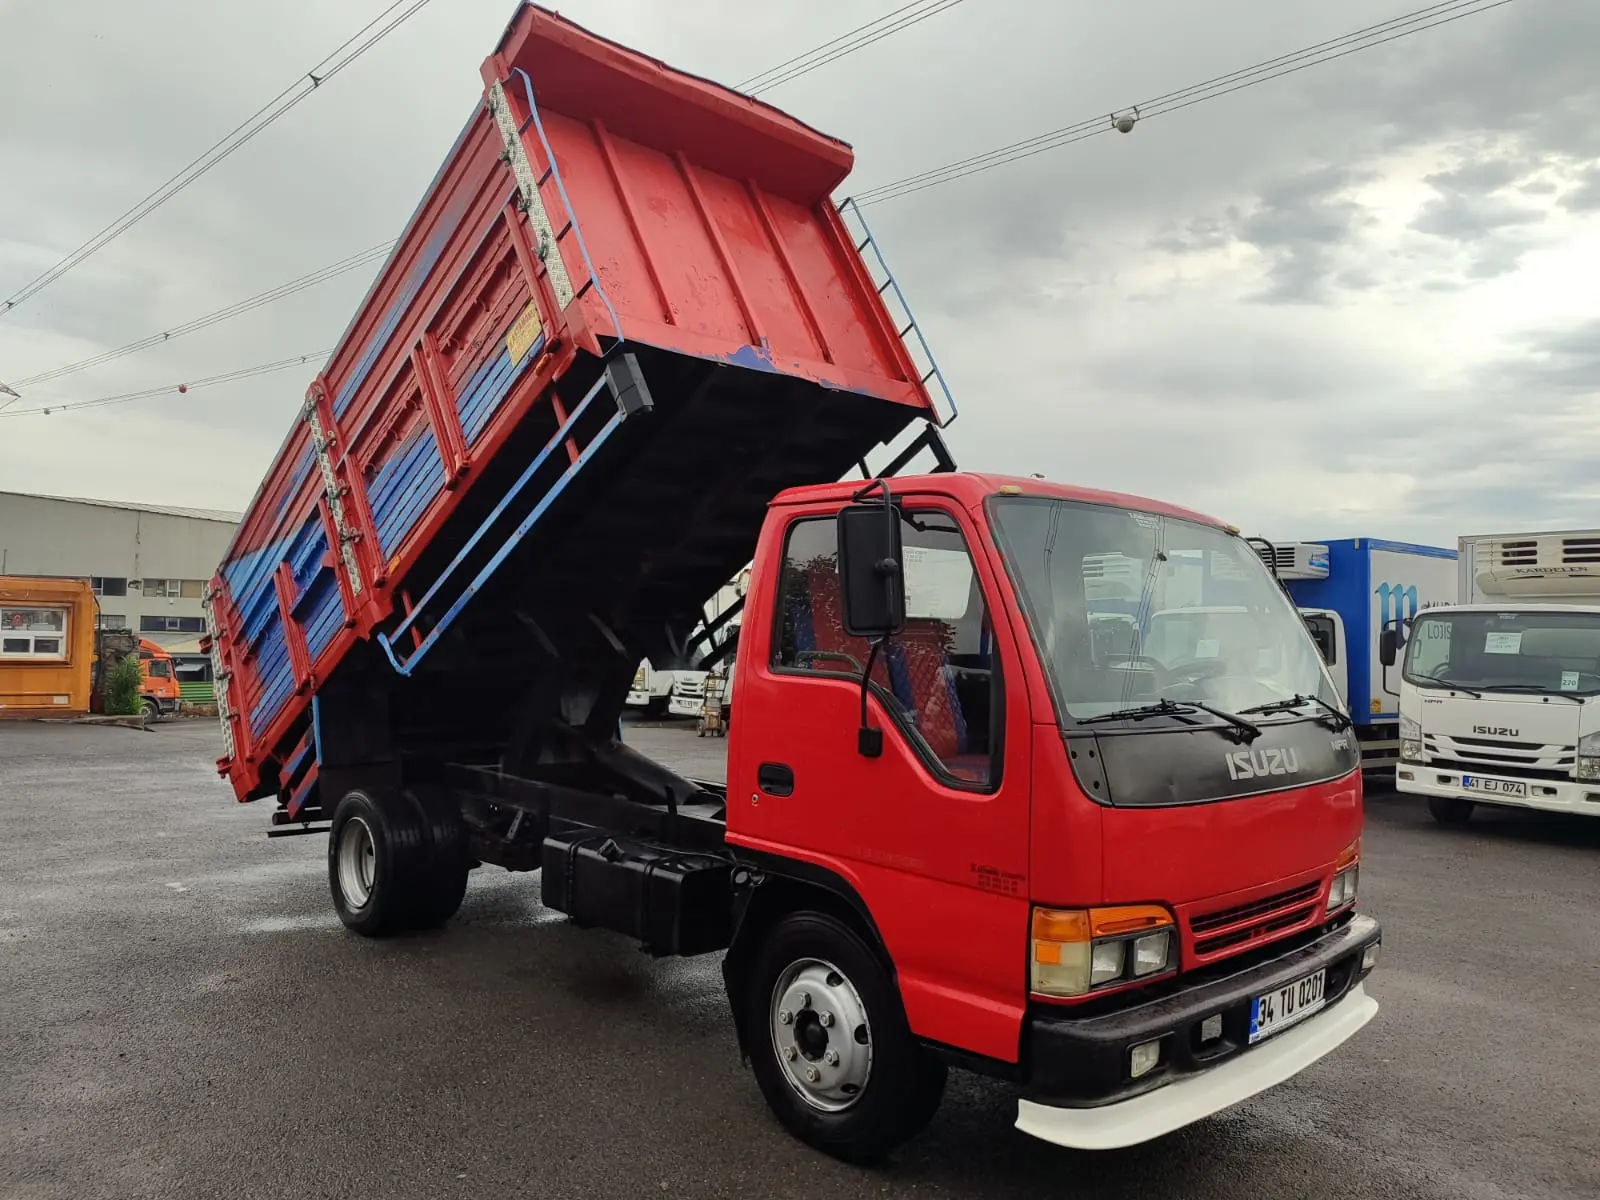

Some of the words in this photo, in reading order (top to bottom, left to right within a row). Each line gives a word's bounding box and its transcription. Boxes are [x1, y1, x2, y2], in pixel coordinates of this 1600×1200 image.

[1515, 566, 1588, 574] KARDELEN
[1473, 725, 1519, 737] ISUZU
[1225, 747, 1299, 781] ISUZU
[1469, 778, 1479, 788] 41
[1484, 780, 1498, 791] EJ
[1502, 782, 1522, 794] 074
[1258, 995, 1274, 1027] 34
[1280, 985, 1295, 1017] TU
[1299, 971, 1323, 1008] 0201
